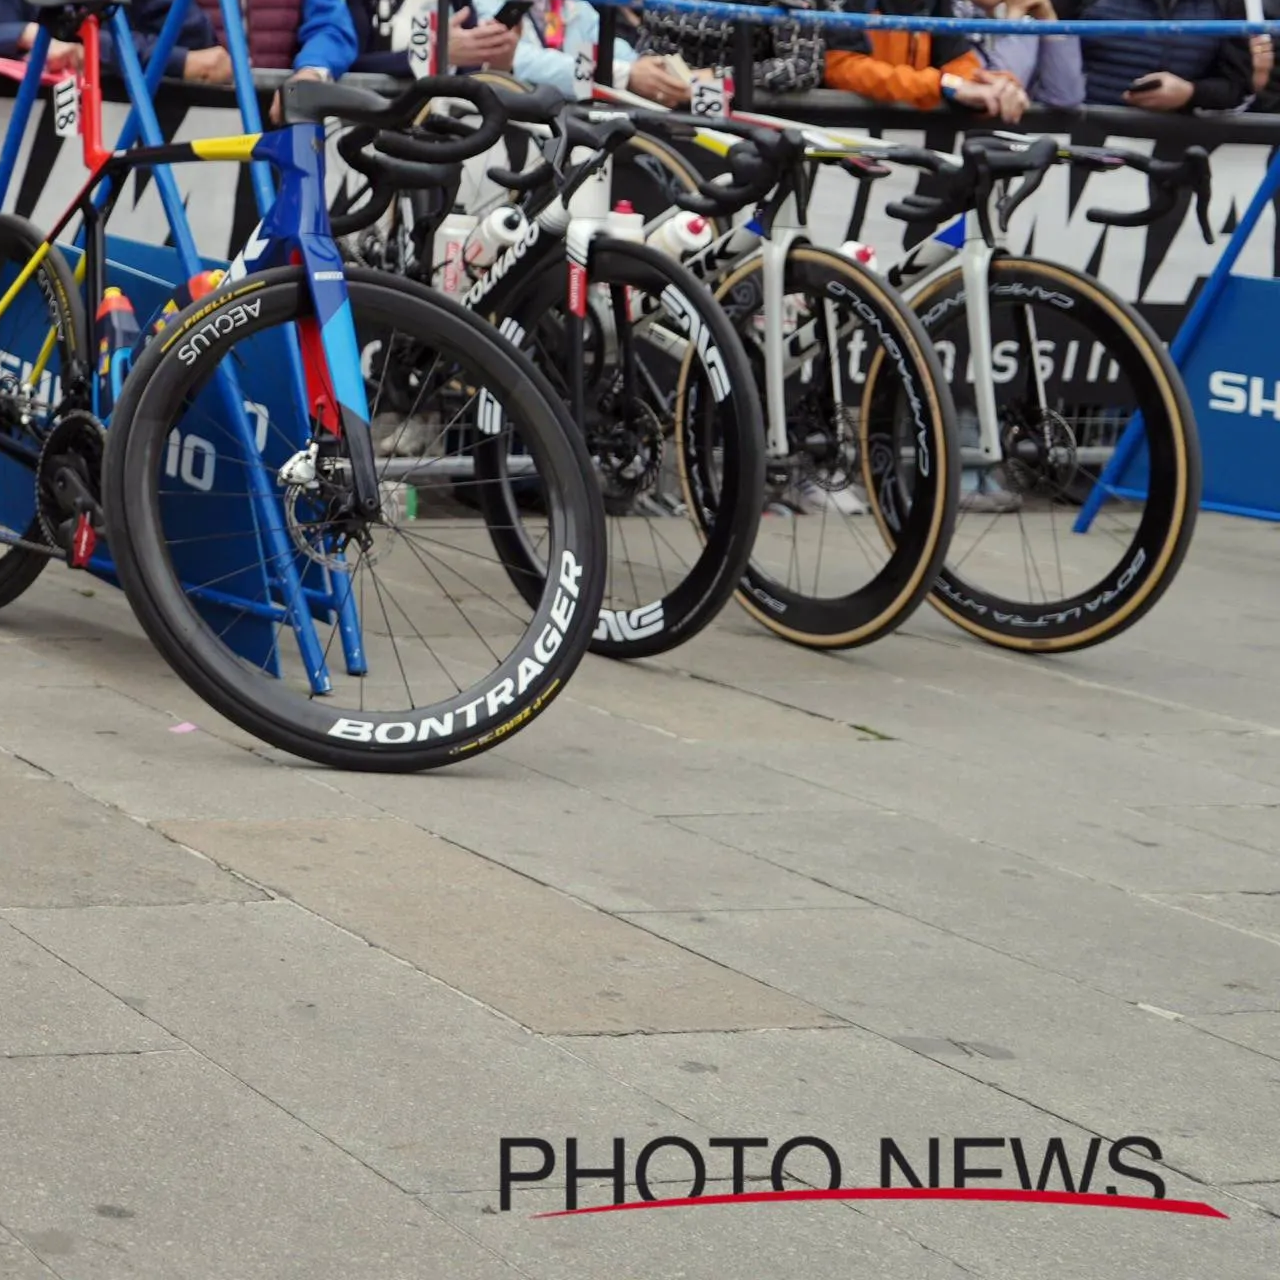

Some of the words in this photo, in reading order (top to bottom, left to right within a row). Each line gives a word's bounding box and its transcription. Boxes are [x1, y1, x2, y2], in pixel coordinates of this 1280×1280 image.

[411, 16, 429, 62] 202
[56, 79, 76, 130] 118
[695, 84, 722, 117] 48
[461, 220, 540, 310] COLNAGO
[184, 292, 235, 330] PIRELLI
[327, 549, 584, 744] BONTRAGER
